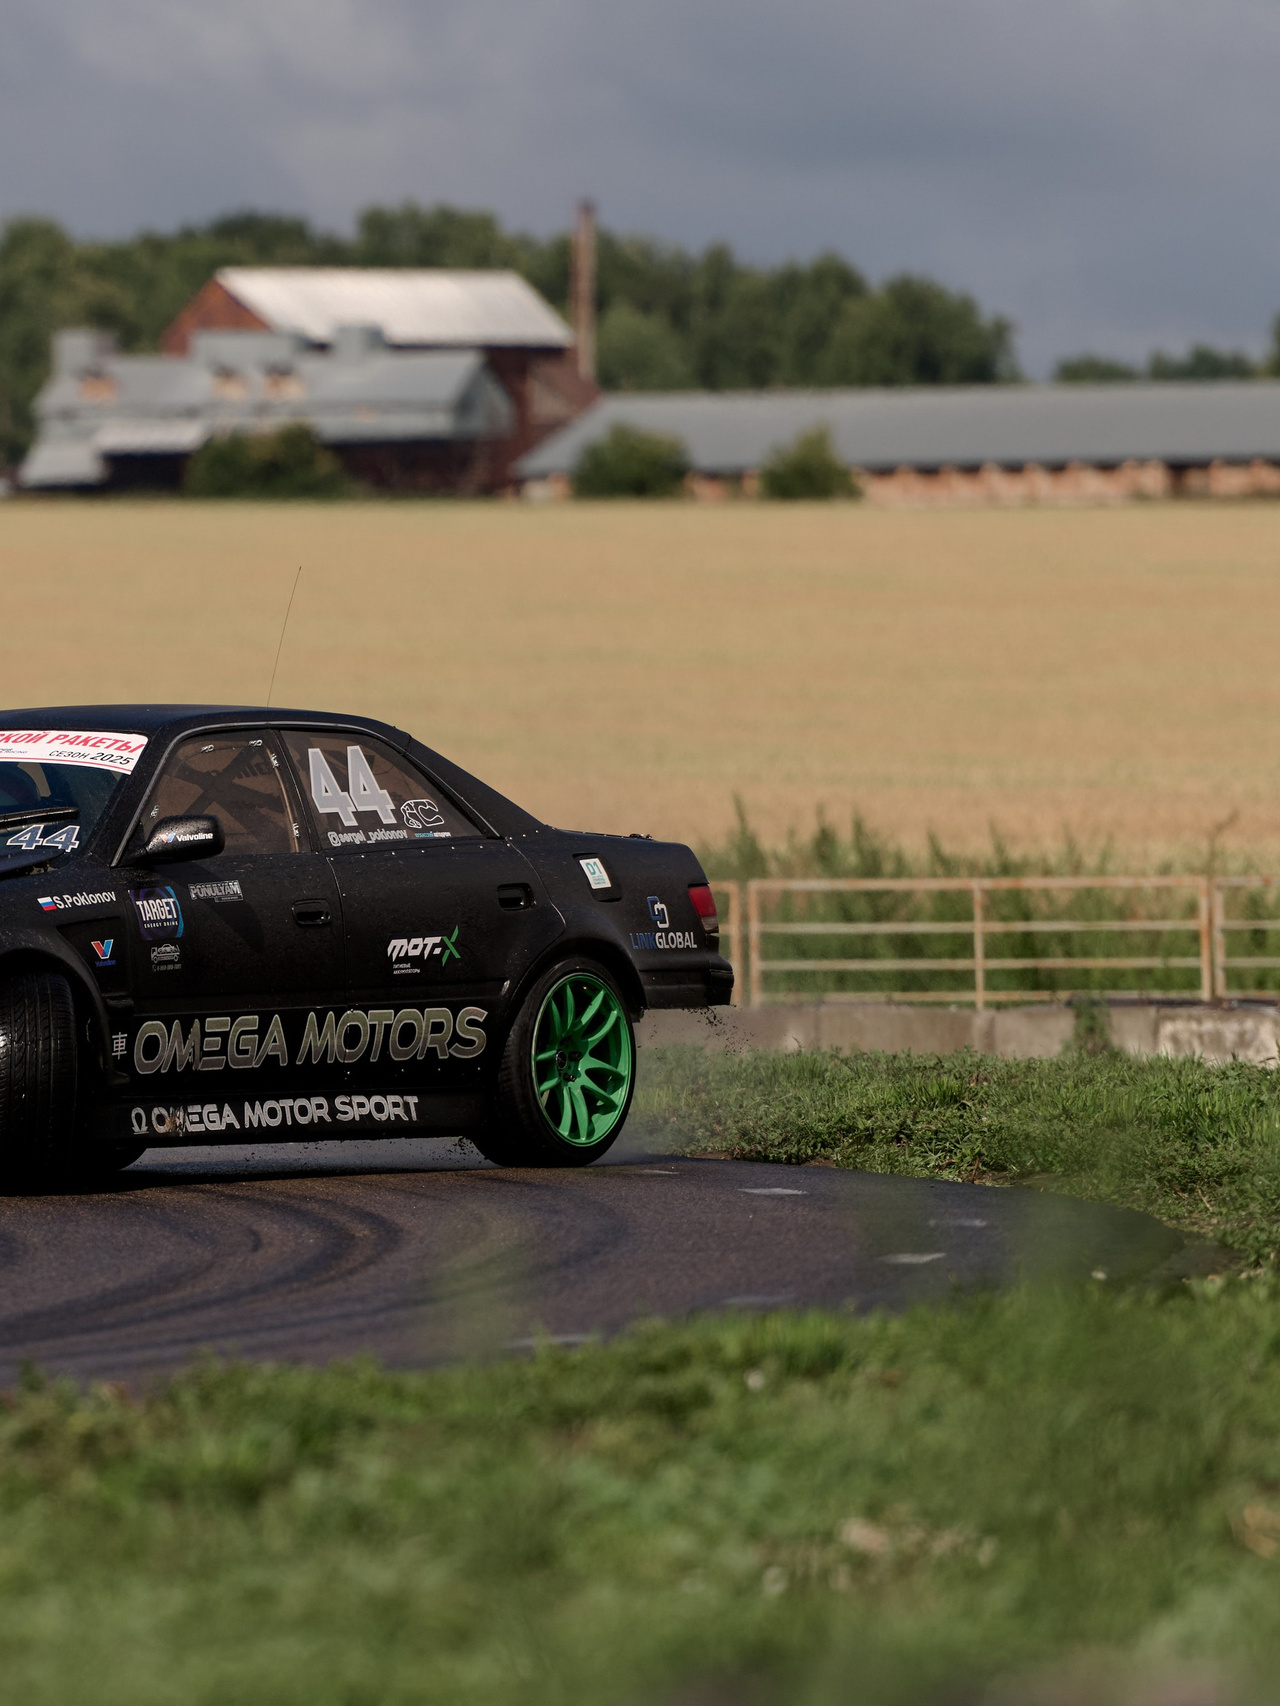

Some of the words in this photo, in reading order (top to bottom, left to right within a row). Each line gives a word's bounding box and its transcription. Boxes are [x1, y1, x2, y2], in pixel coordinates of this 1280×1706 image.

[47, 734, 145, 753] РАКЕТЫ
[49, 750, 89, 759] СЕЗОН
[90, 752, 134, 765] 2025
[308, 746, 398, 826] 44
[7, 824, 80, 852] 44
[176, 832, 213, 842] Valvoline
[585, 861, 603, 875] D1
[53, 890, 117, 909] S.Poklonov
[136, 898, 177, 921] TARGET
[111, 1032, 127, 1060] 車
[134, 1014, 288, 1074] OMEGA
[296, 1006, 489, 1065] MOTORS
[244, 1097, 332, 1128] MOTOR
[335, 1095, 419, 1122] SPORT
